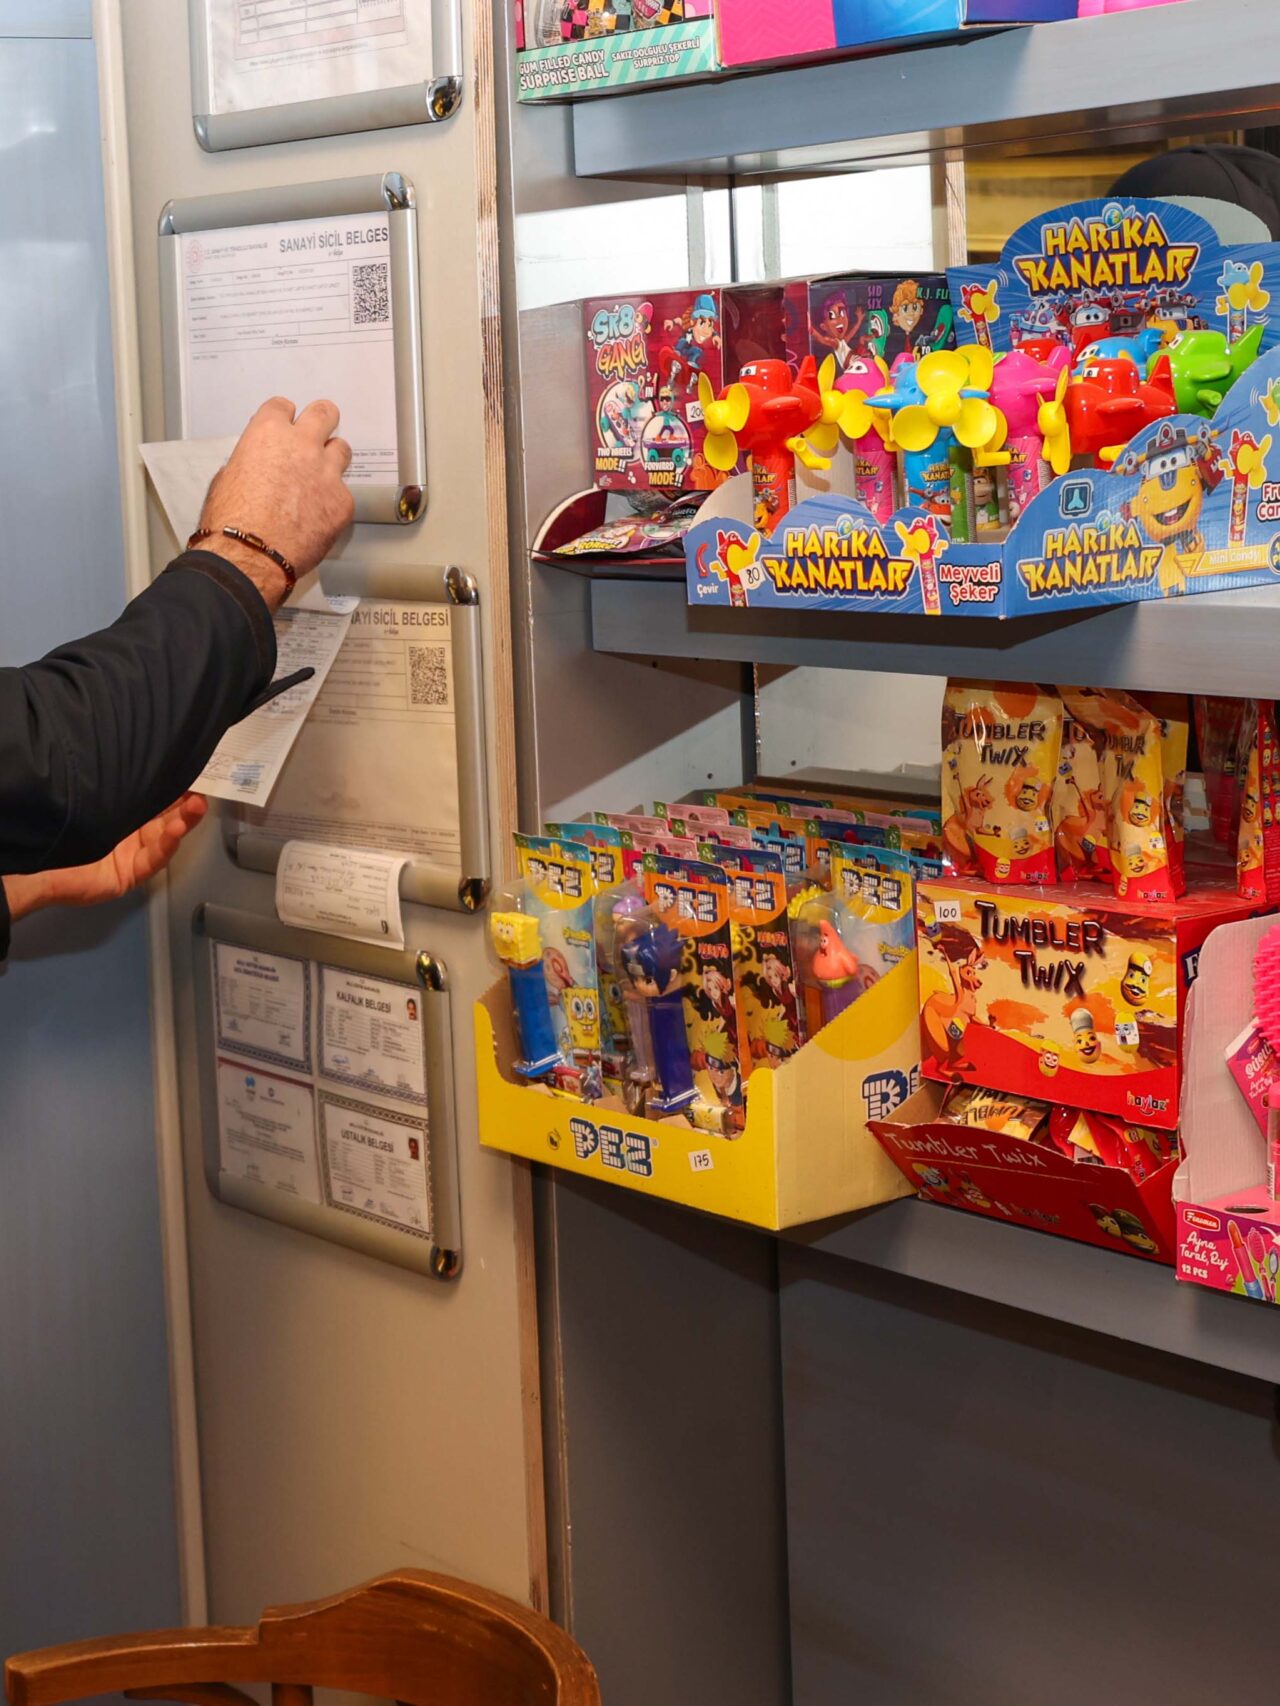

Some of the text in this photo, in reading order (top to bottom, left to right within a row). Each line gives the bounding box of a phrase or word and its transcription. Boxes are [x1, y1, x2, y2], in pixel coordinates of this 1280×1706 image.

[611, 36, 700, 62] SAKIZ DOLGULU ŞEKERLİ
[666, 53, 680, 64] TOP
[519, 50, 605, 75] GUM FILLED CANDY
[520, 63, 609, 91] SURPRISE BALL
[279, 232, 316, 253] SANAYİ
[318, 229, 343, 249] SİCİL
[1019, 246, 1198, 291] KANATLAR
[867, 286, 883, 298] SID
[867, 298, 882, 310] SIX
[592, 304, 636, 347] SK8
[597, 335, 647, 378] GANG
[746, 569, 761, 586] 80
[768, 557, 913, 592] KANATLAR
[940, 563, 1001, 586] Meyveli
[1021, 548, 1163, 592] KANATLAR
[696, 582, 719, 599] Çevir
[950, 583, 998, 606] Şeker
[373, 607, 400, 626] SİCİL
[401, 608, 449, 627] BELGESİ
[953, 712, 1046, 742] TUMBLER
[977, 743, 1029, 768] TWIX
[528, 857, 583, 898] PEZ
[841, 867, 902, 911] PEZ
[654, 882, 718, 924] PEZ
[938, 905, 958, 919] 100
[974, 900, 1105, 955] TUMBLER
[1013, 949, 1086, 996] TWIX
[1126, 1090, 1167, 1112] haylaz
[569, 1116, 654, 1178] PEZ
[883, 1132, 1048, 1168] Tumbler Twix
[692, 1152, 710, 1168] 175
[1187, 1231, 1217, 1252] Ayna
[1179, 1243, 1229, 1271] Tarak, Ruj
[1181, 1263, 1209, 1279] 12 PCS
